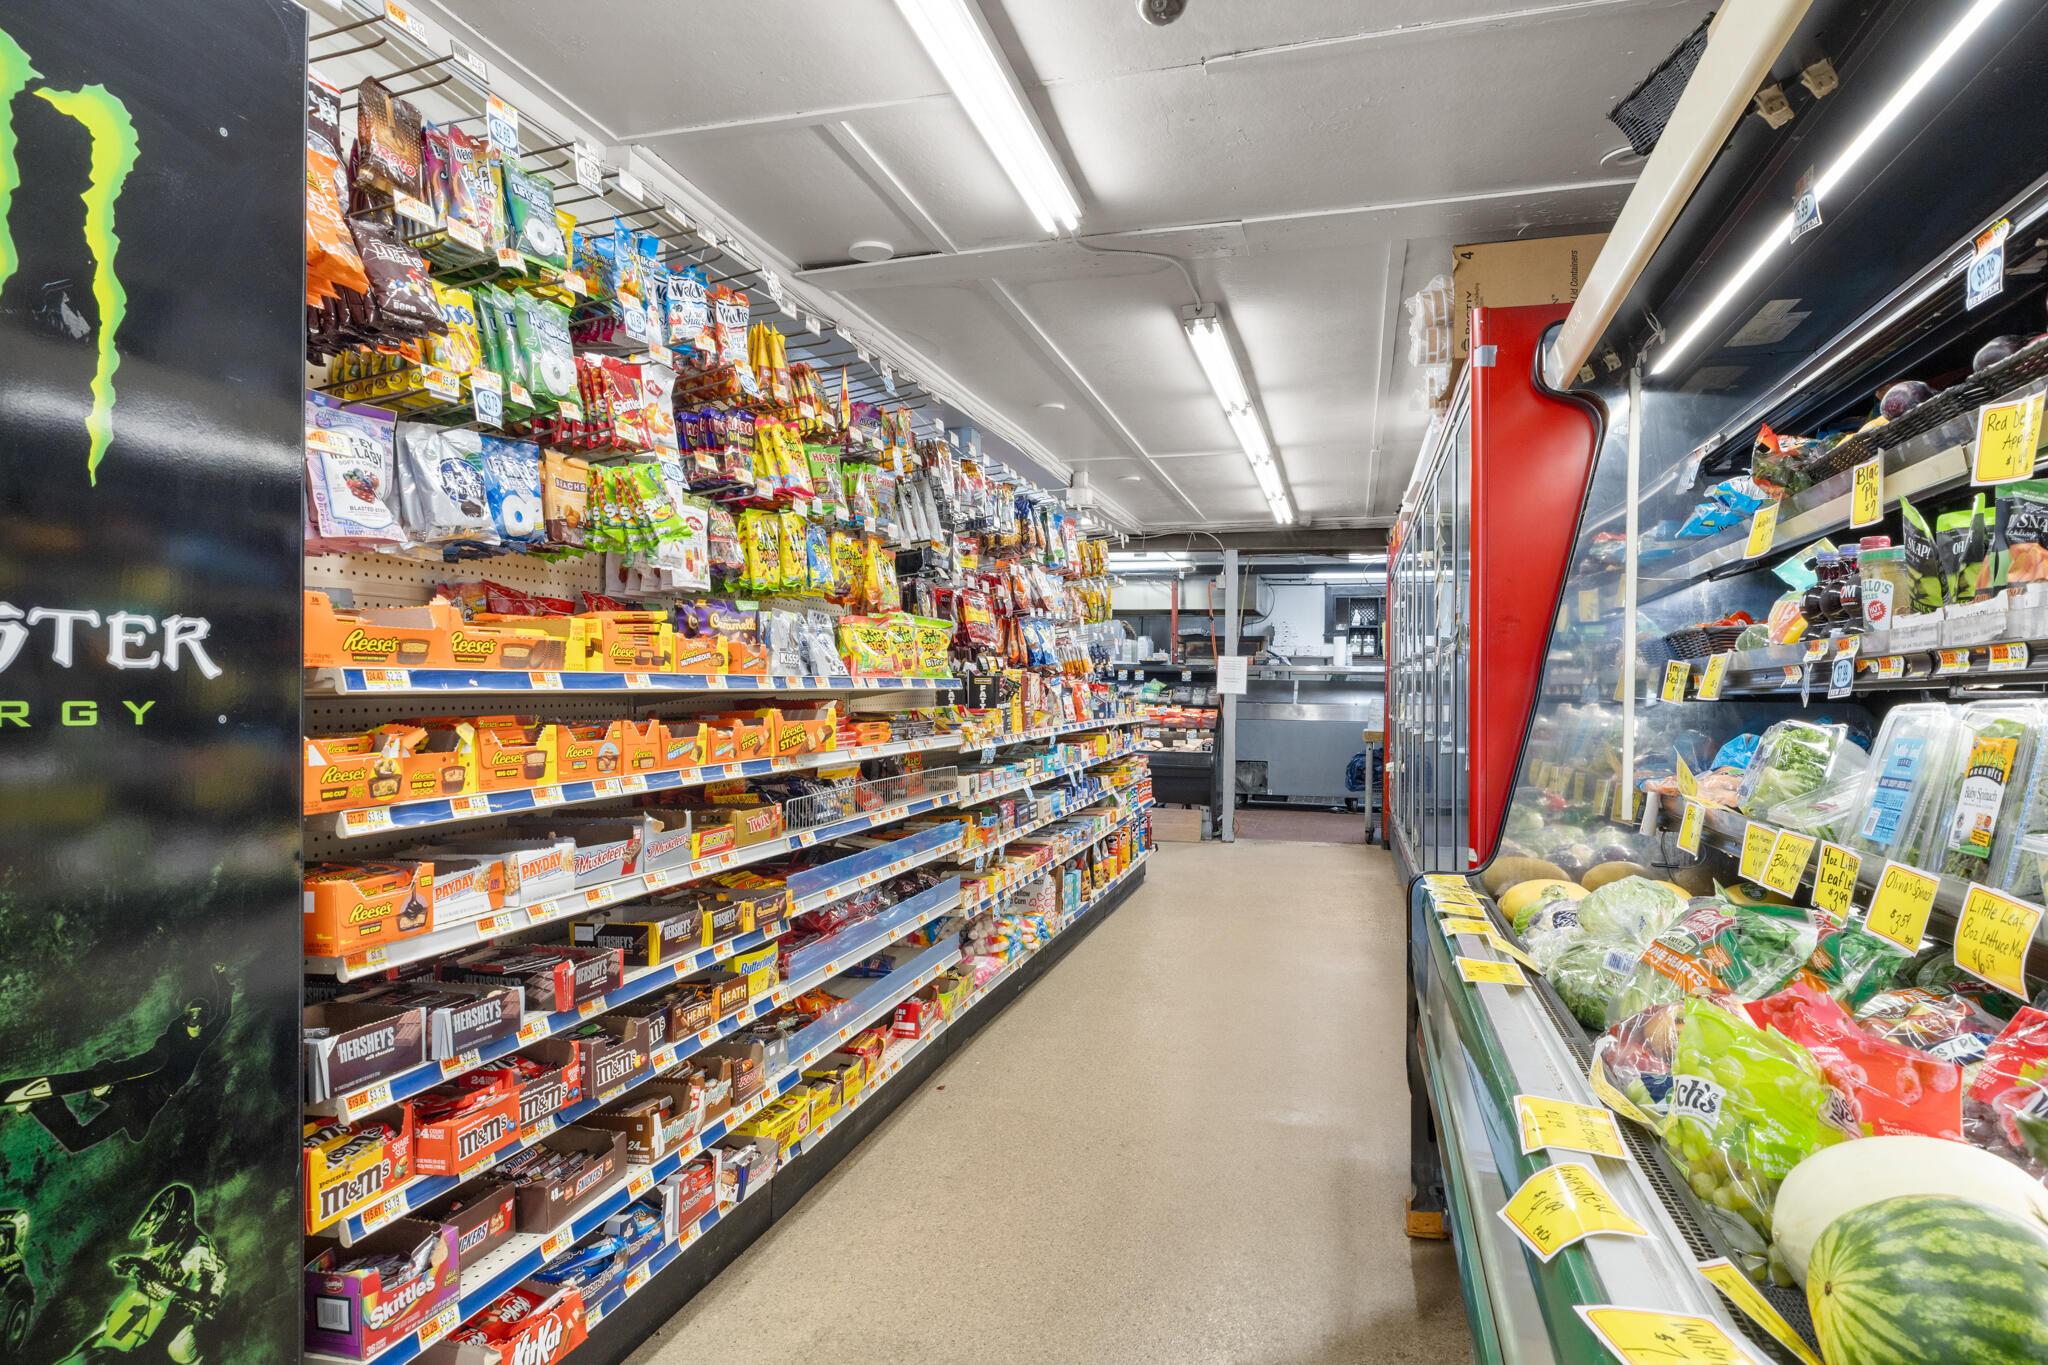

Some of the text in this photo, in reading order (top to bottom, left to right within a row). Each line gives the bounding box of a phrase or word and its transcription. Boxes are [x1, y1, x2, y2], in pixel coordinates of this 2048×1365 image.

[1460, 251, 1474, 260] 4
[1569, 250, 1579, 289] Containers
[1986, 412, 2008, 432] Red
[342, 628, 400, 653] Reese's
[451, 630, 497, 654] Reese's
[609, 642, 637, 658] Reese's
[867, 641, 888, 651] ATCH
[780, 722, 804, 741] Reese's
[491, 750, 524, 766] Reese's
[565, 743, 593, 759] Reese's
[320, 764, 367, 785] Reese's
[1968, 766, 2004, 786] ORGANICS
[521, 851, 562, 880] PAYDAY
[434, 872, 475, 902] PAYDAY
[1820, 867, 1845, 887] Leaf
[349, 902, 393, 924] Reese's
[713, 907, 736, 928] HERSHEY'S
[1969, 895, 1998, 921] Little
[664, 919, 691, 941] HERSHEY'S
[1962, 917, 1979, 941] 8oz
[1979, 926, 2010, 956] Lettuce
[1664, 934, 1696, 952] ARVEST
[575, 959, 608, 986] HERSHEY'S
[1666, 950, 1706, 987] HEARTS
[721, 984, 747, 1006] HEATH
[453, 999, 502, 1034] HERSHEY'S
[687, 1002, 712, 1024] HEATH
[337, 1026, 396, 1064] HERSHEY'S
[471, 1075, 485, 1085] 24
[368, 1086, 386, 1102] $3.19
[392, 1135, 410, 1153] SHARE
[395, 1145, 408, 1159] SIZE
[627, 1141, 640, 1150] 24
[369, 1276, 437, 1330] Skittles
